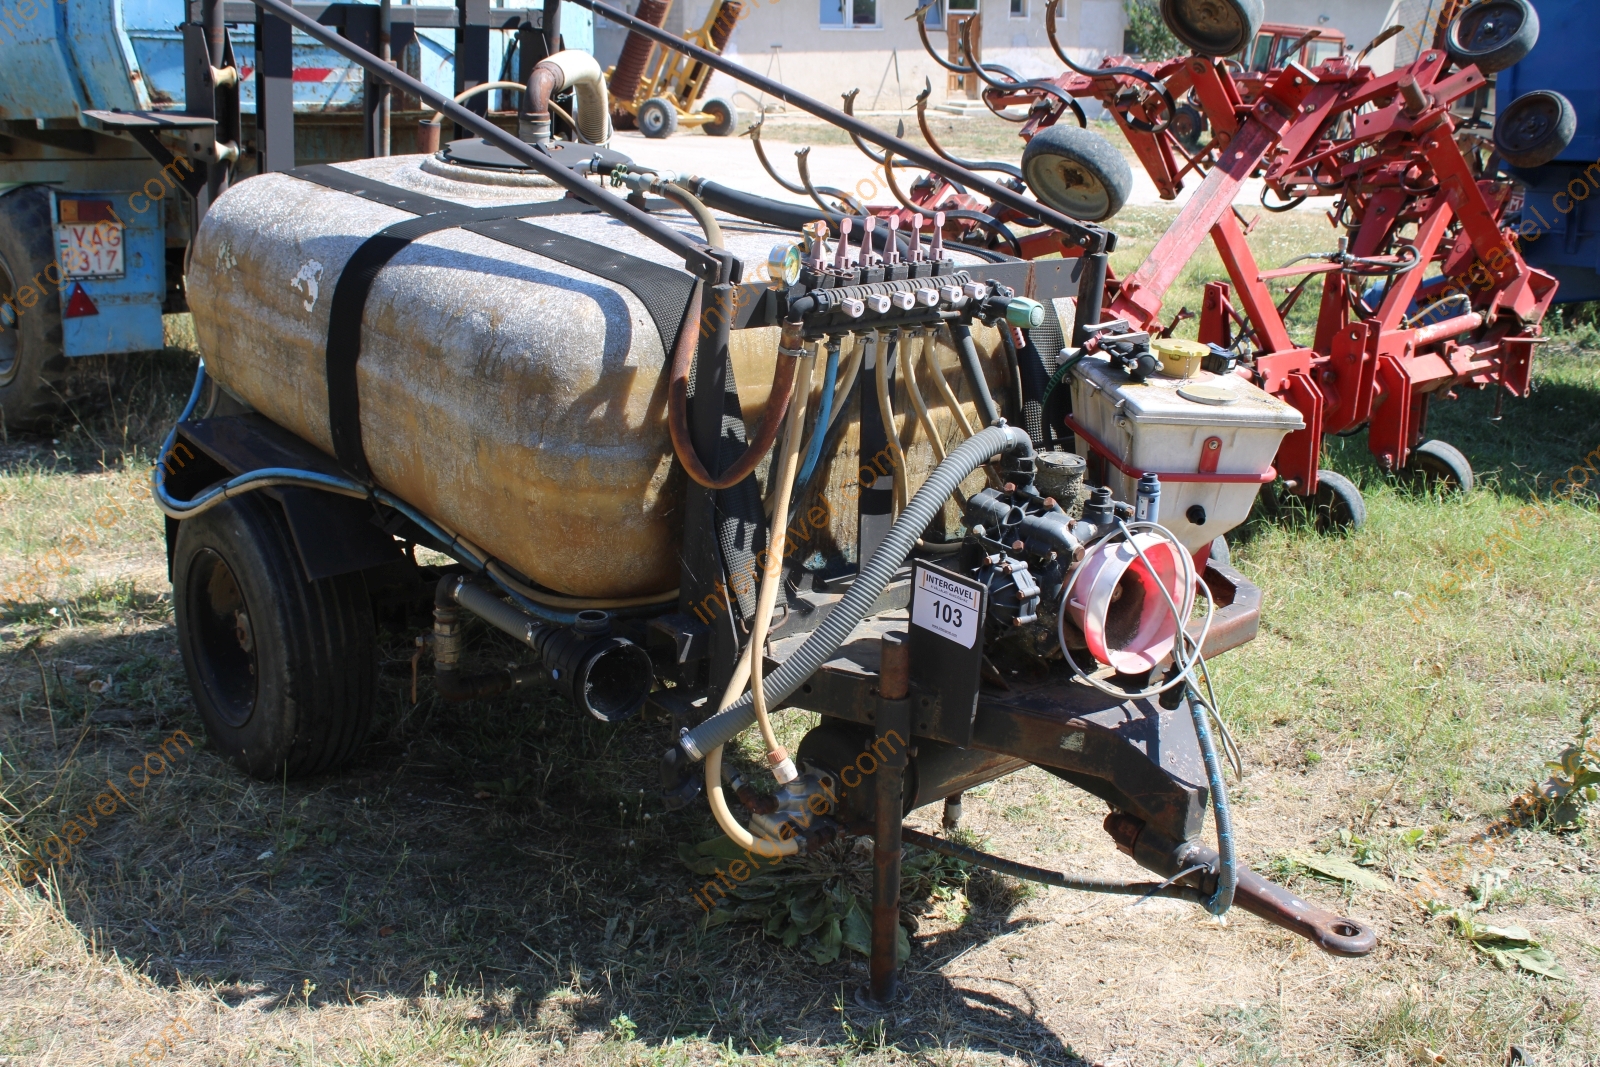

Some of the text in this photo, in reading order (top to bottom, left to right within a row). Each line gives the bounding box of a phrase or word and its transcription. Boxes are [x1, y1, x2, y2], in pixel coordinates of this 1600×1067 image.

[79, 250, 117, 271] 317
[926, 574, 973, 600] INTERGAVEL
[933, 600, 962, 627] 103
